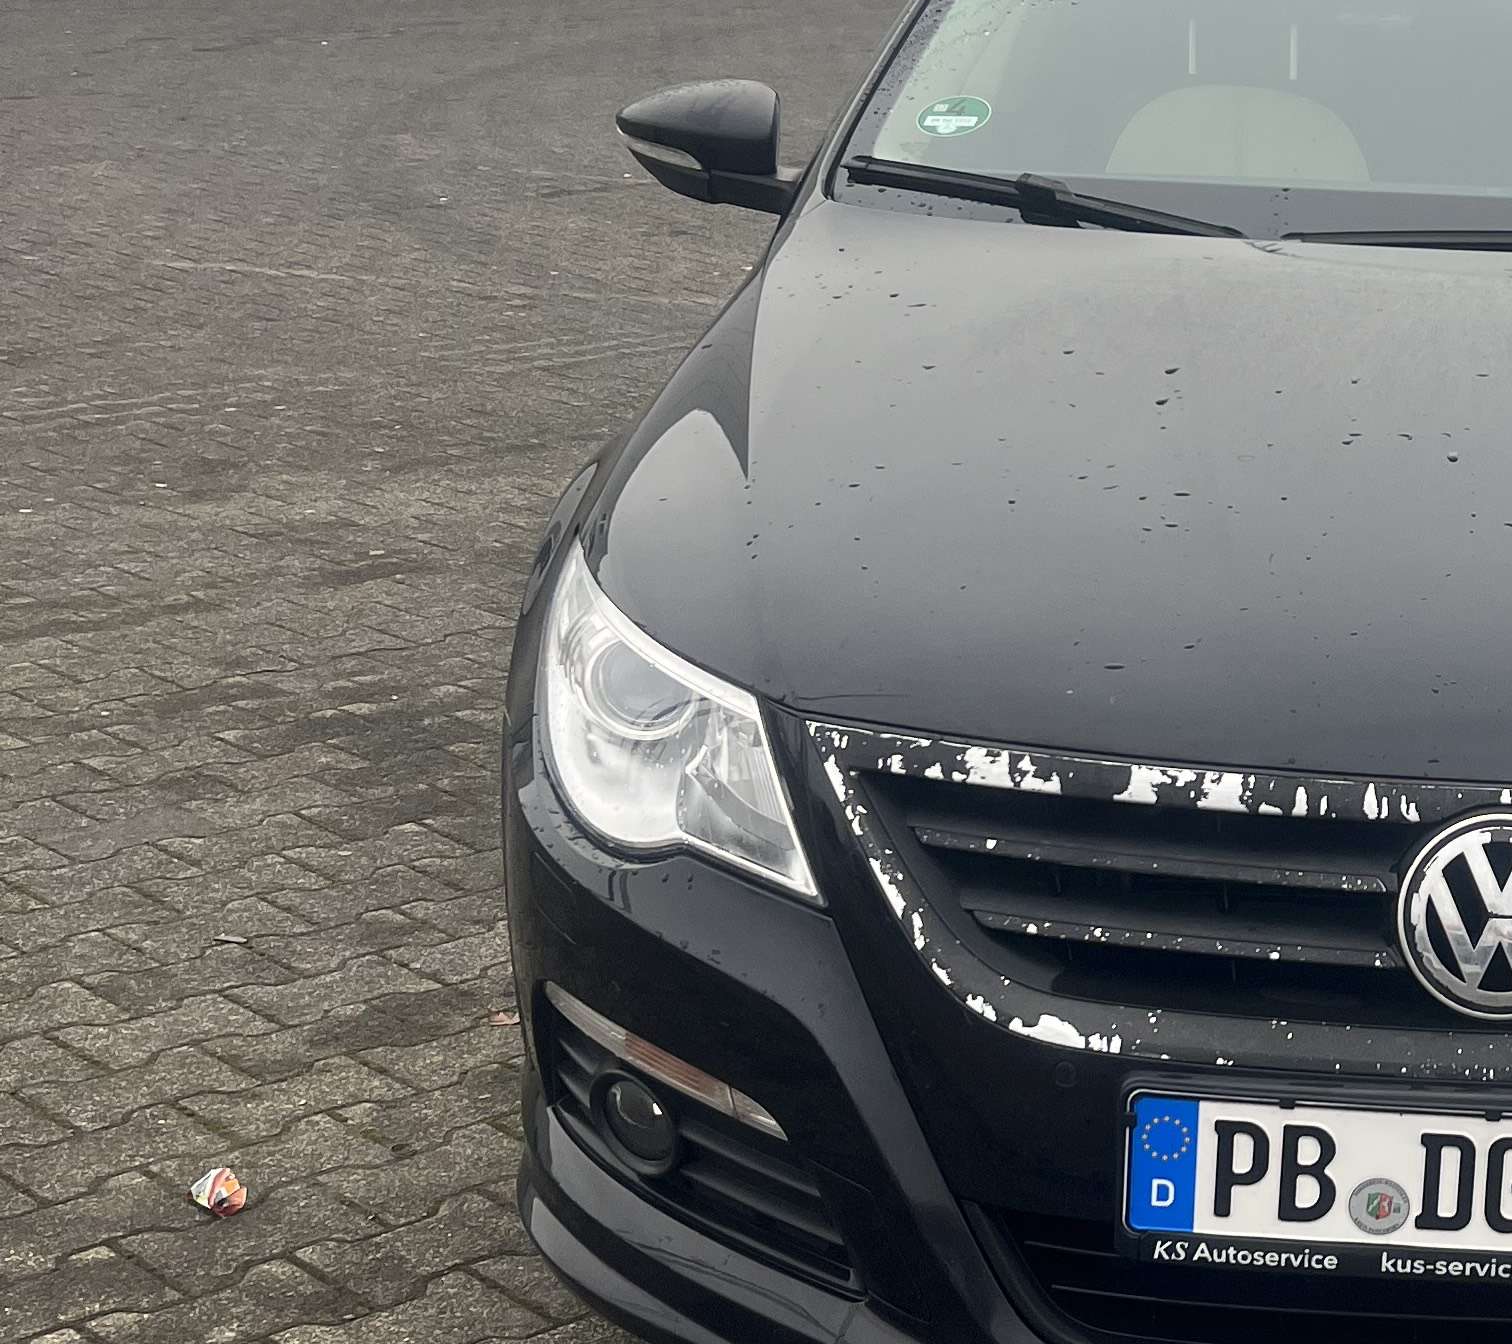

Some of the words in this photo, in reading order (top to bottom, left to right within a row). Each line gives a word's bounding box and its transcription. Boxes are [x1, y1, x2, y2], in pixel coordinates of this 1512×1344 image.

[1212, 1118, 1338, 1223] PB
[1150, 1178, 1176, 1208] D
[1153, 1239, 1190, 1262] KS
[1191, 1241, 1339, 1271] Autoservice
